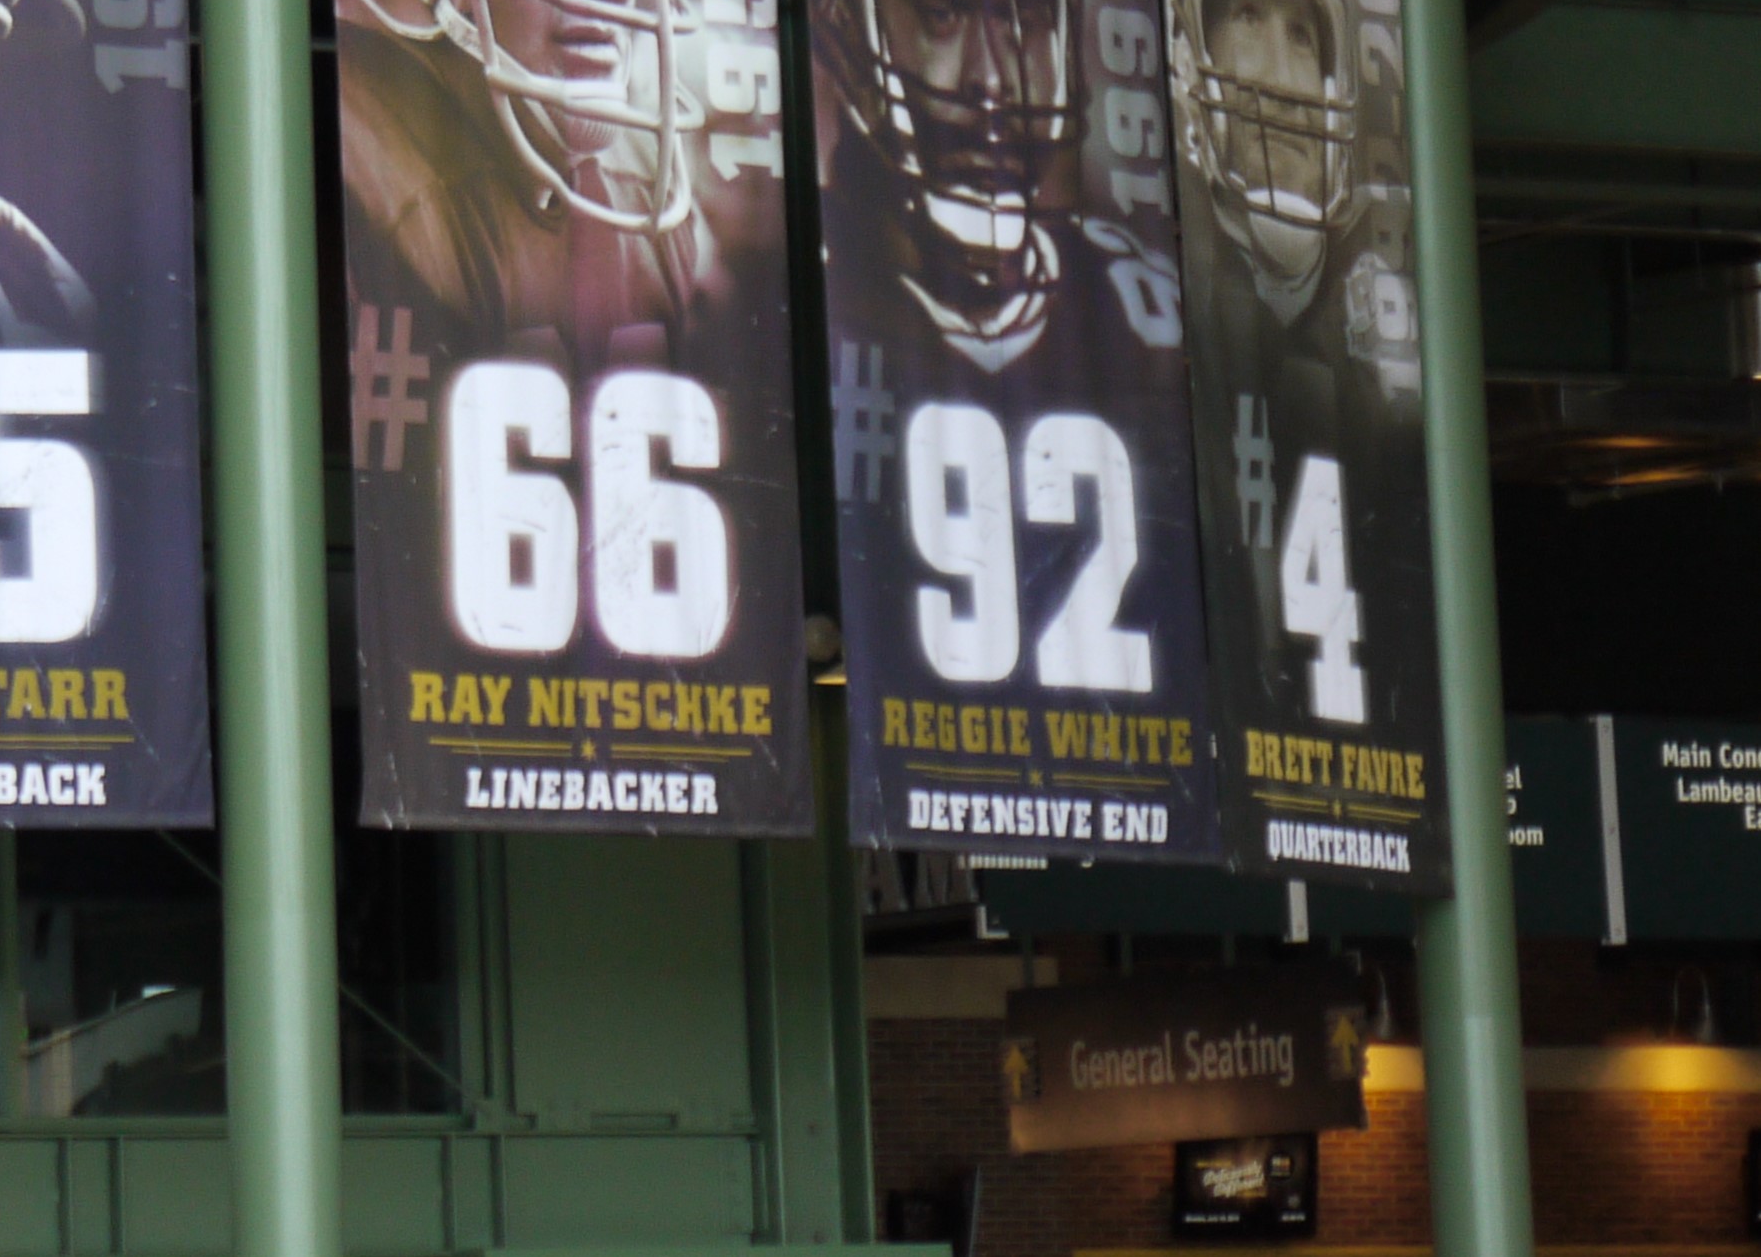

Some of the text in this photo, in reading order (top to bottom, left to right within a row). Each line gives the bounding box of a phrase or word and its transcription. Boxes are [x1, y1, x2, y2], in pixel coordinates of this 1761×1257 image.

[449, 362, 729, 656] 66
[906, 403, 1153, 693] 92
[1281, 455, 1364, 724] 4
[409, 672, 772, 735] RAY NITSCHKE
[882, 698, 1194, 766] REGGIE WHITE
[1244, 729, 1427, 799] BRETT FAVRE
[1663, 743, 1711, 767] Main
[466, 767, 719, 815] LINEBACKER
[907, 789, 1169, 844] DEFENSIVE END
[1267, 820, 1411, 873] QUARTERBACK
[1069, 1024, 1294, 1091] General Seating
